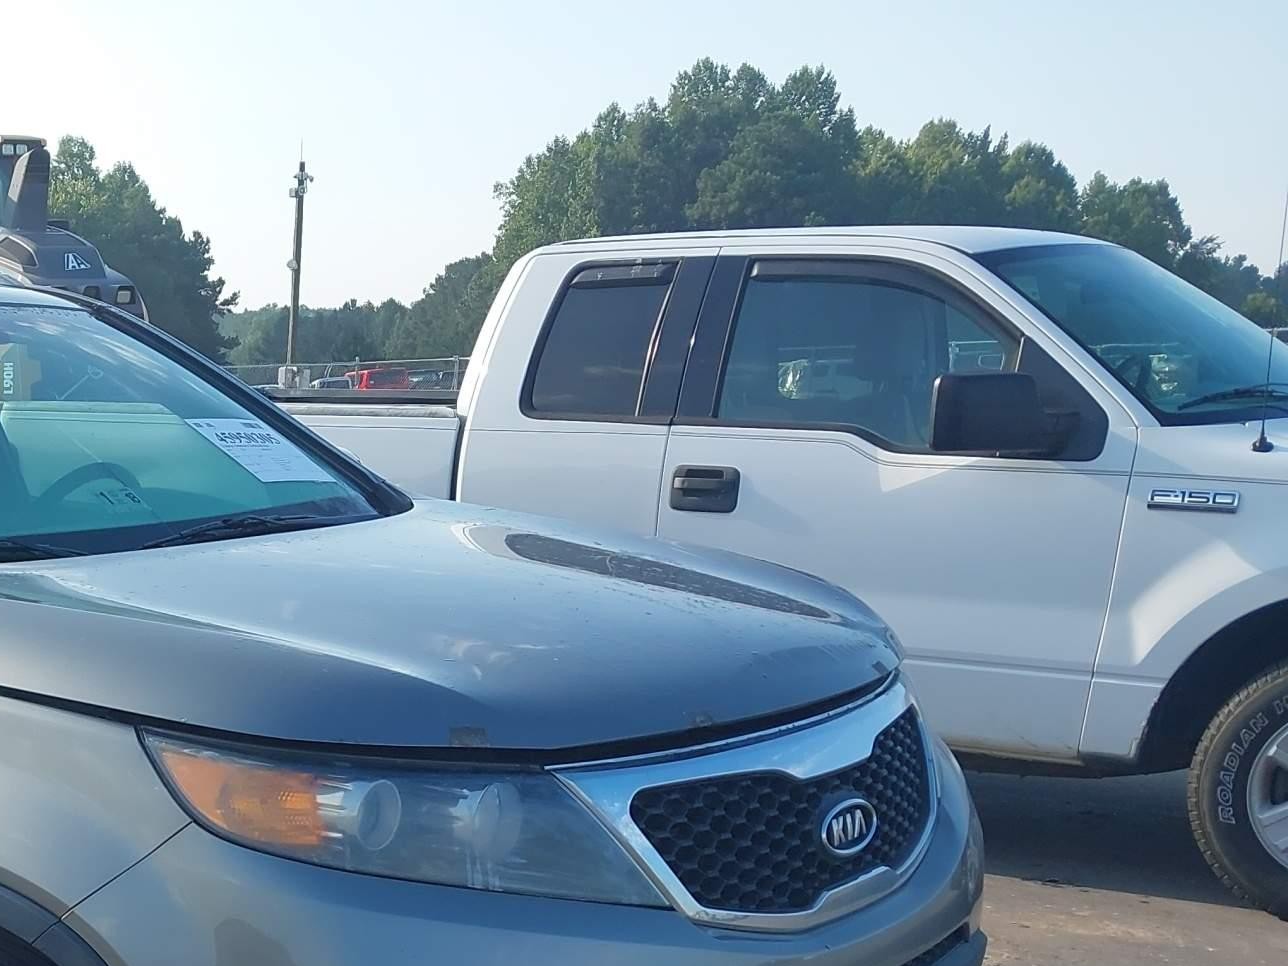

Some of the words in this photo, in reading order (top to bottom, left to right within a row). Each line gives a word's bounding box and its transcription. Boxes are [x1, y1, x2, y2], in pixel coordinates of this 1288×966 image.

[3, 362, 14, 395] L90H
[214, 431, 281, 445] 45950305
[1217, 712, 1269, 824] ROADIAN
[831, 808, 867, 847] KIA
